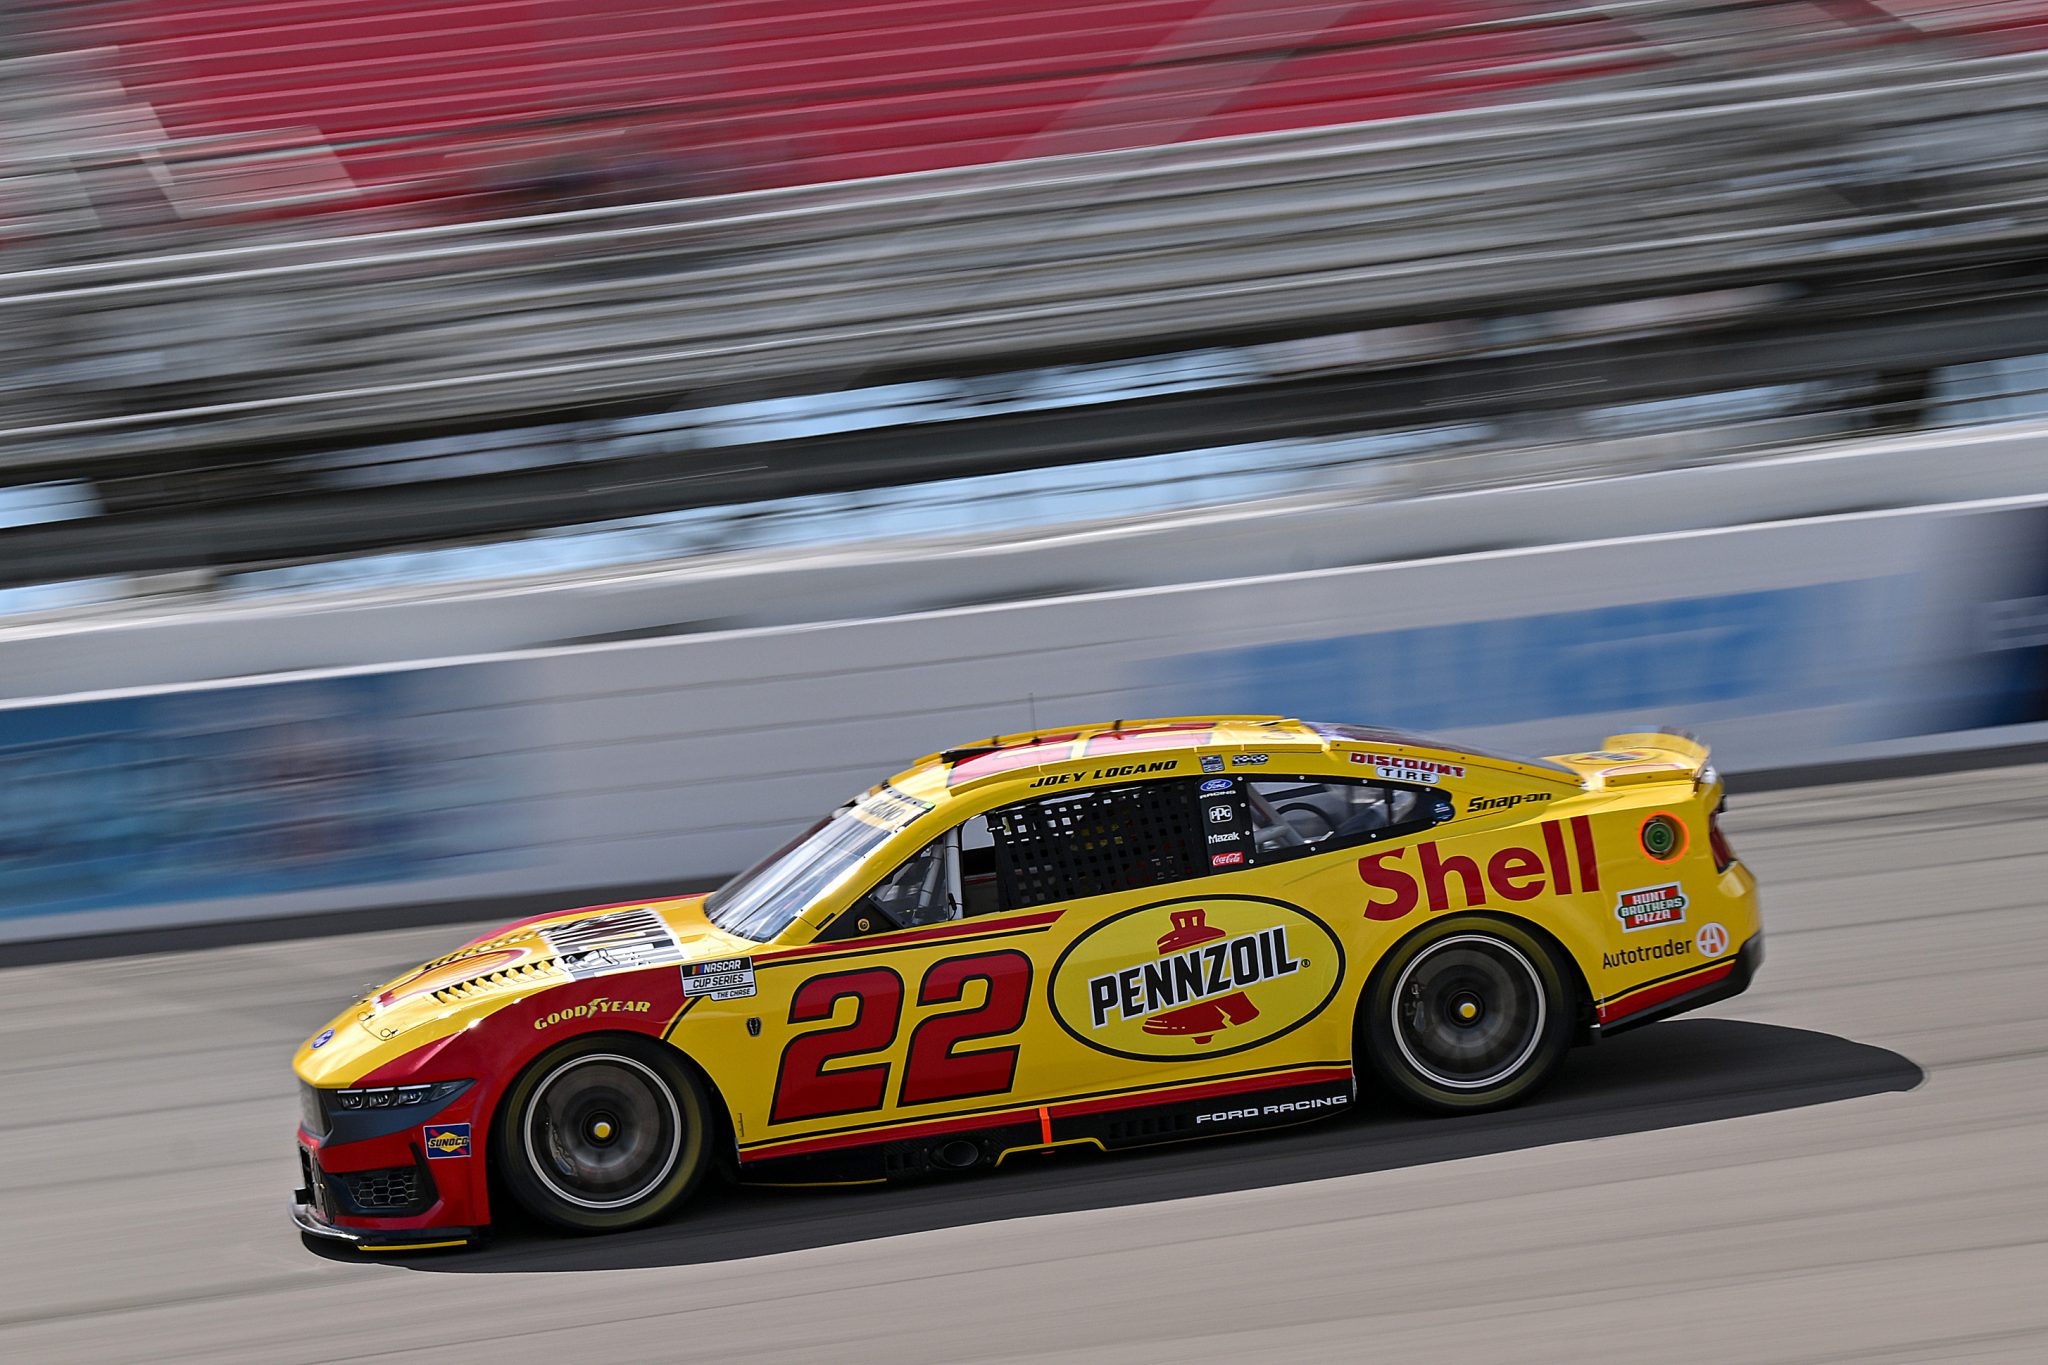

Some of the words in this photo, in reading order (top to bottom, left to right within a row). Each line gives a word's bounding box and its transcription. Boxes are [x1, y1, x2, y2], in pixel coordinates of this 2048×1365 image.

[1029, 771, 1087, 789] JOEY
[1093, 760, 1179, 780] LOGANO
[1350, 752, 1465, 778] DISCOUNT
[1383, 767, 1433, 782] TIRE
[1466, 792, 1552, 814] Snap-on
[1210, 807, 1232, 821] PPG
[1208, 831, 1240, 844] Mazak
[1357, 815, 1601, 922] Shell
[1620, 897, 1683, 918] BROTHERS
[1632, 889, 1667, 905] HUNT
[1634, 909, 1672, 925] PIZZA
[1602, 938, 1693, 970] Autotrader
[703, 959, 742, 974] NASCAR
[1088, 924, 1301, 1030] PENNZOIL
[693, 978, 712, 988] CUP
[712, 974, 744, 986] SERIES
[717, 990, 729, 999] THE
[730, 988, 751, 998] CHASE
[533, 997, 651, 1030] GOODYEAR
[767, 948, 1034, 1127] 22
[1196, 1108, 1259, 1124] FORD
[1263, 1095, 1348, 1115] RACING
[428, 1136, 470, 1148] SUNOCO
